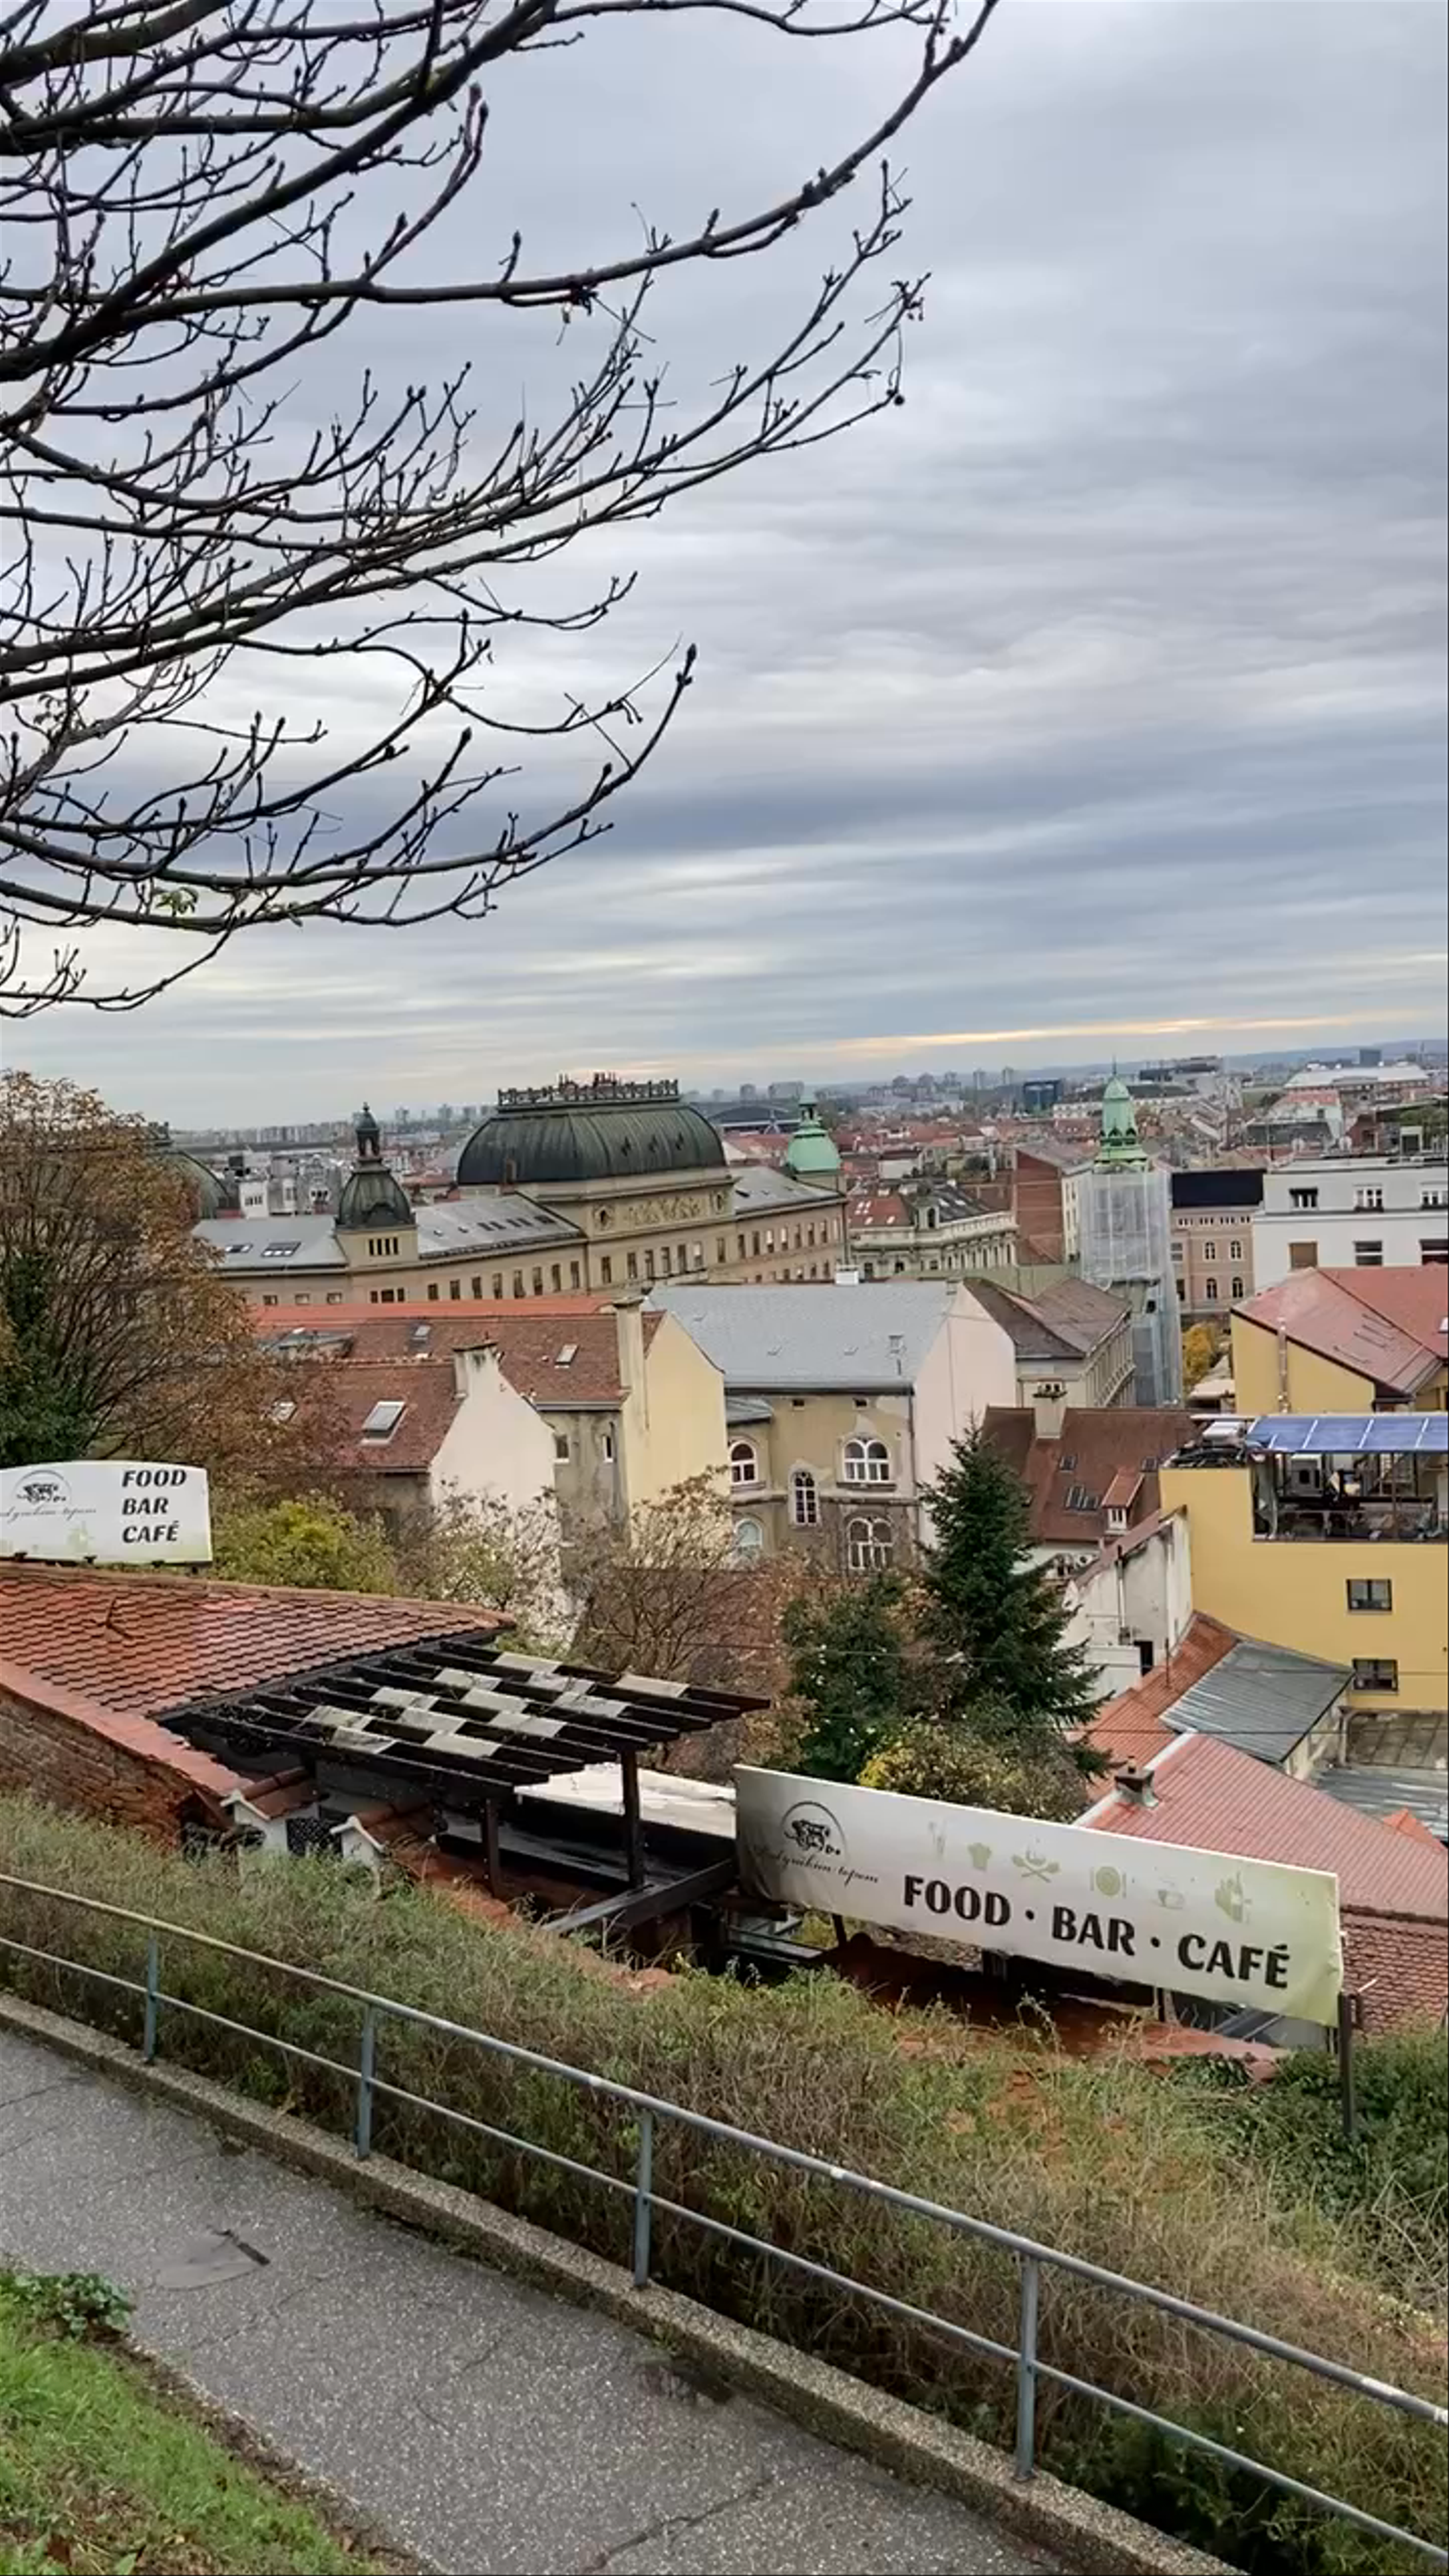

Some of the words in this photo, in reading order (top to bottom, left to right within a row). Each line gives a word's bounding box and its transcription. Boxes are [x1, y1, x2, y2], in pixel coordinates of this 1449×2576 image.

[122, 1469, 187, 1487] FOOD
[122, 1497, 169, 1515] BAR
[122, 1520, 179, 1543] CAFÉ
[903, 1874, 1011, 1927] FOOD
[1051, 1905, 1136, 1957] BAR
[1177, 1933, 1291, 1990] CAFÉ
